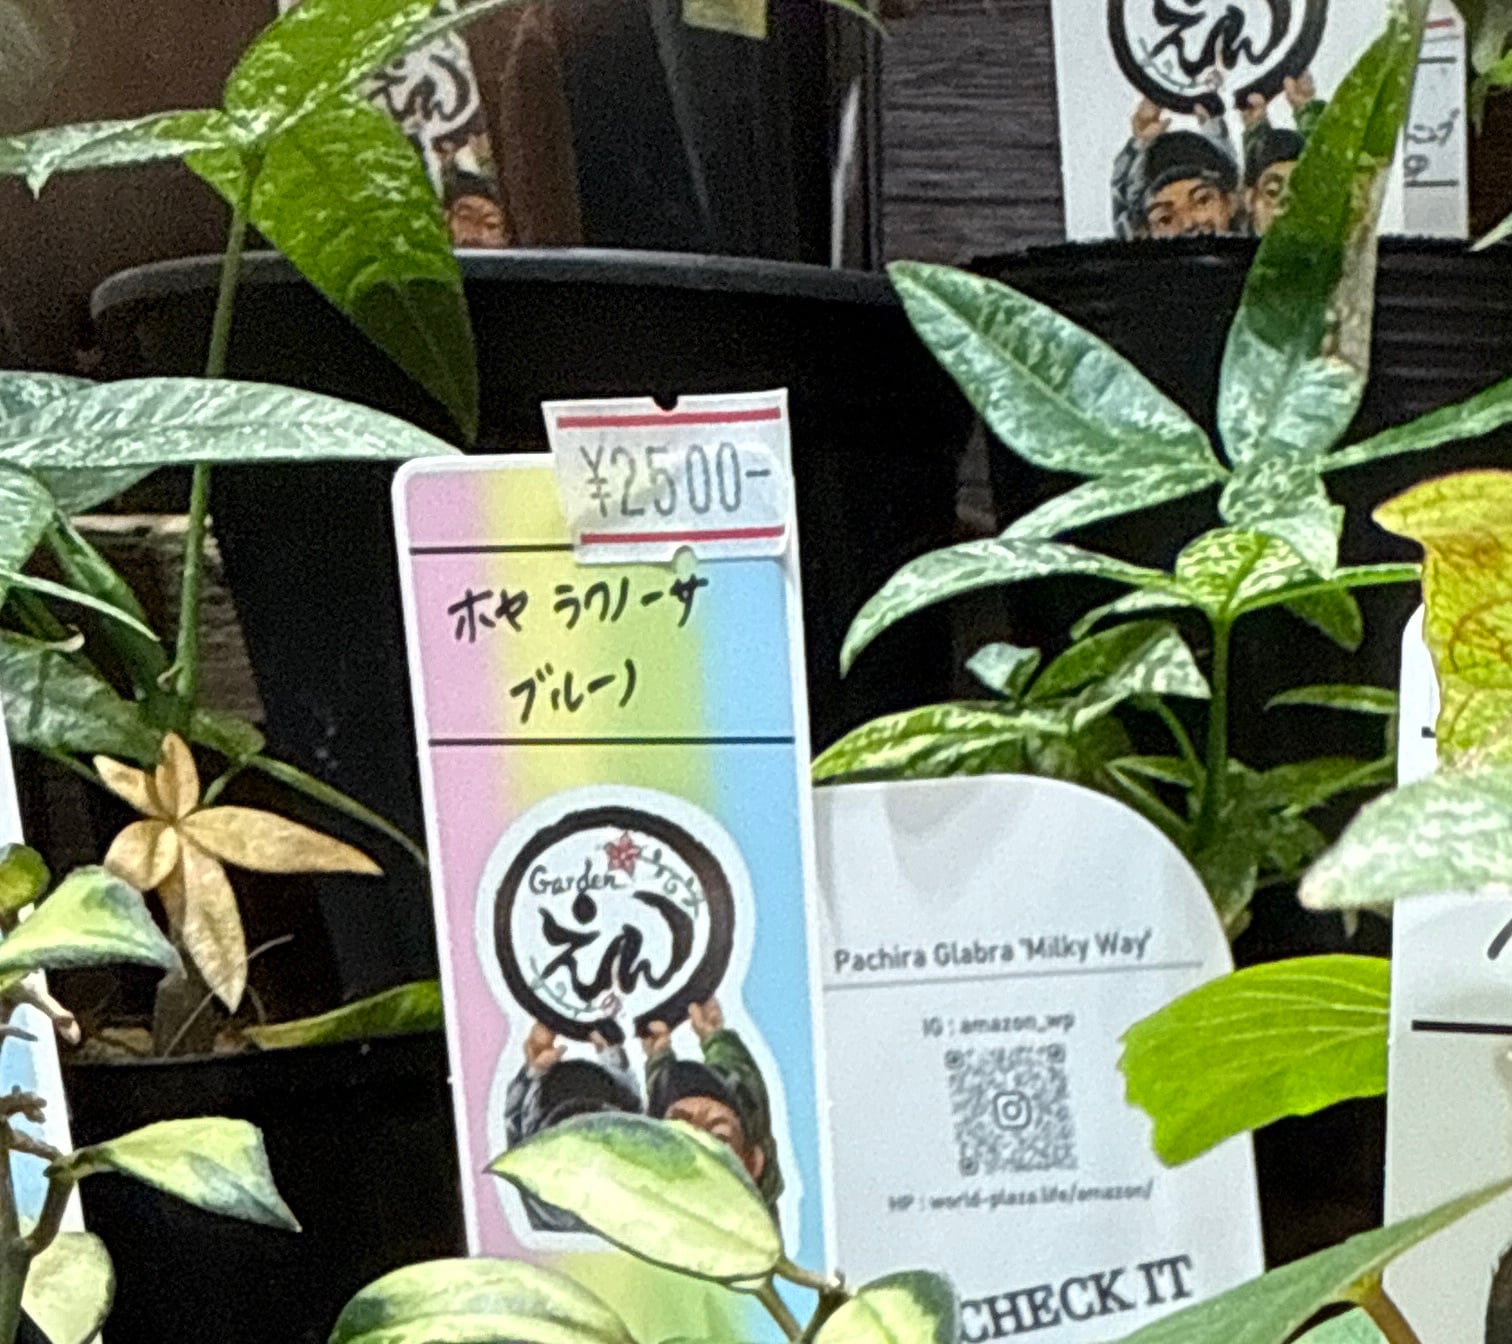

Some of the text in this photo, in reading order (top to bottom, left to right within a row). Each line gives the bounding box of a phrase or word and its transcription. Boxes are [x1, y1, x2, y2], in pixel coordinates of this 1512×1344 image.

[448, 588, 529, 643] ホヤ
[528, 857, 633, 896] Garden
[834, 946, 928, 973] Pachira
[933, 940, 1016, 968] Glabra
[957, 1253, 1195, 1344] CHECK IT
